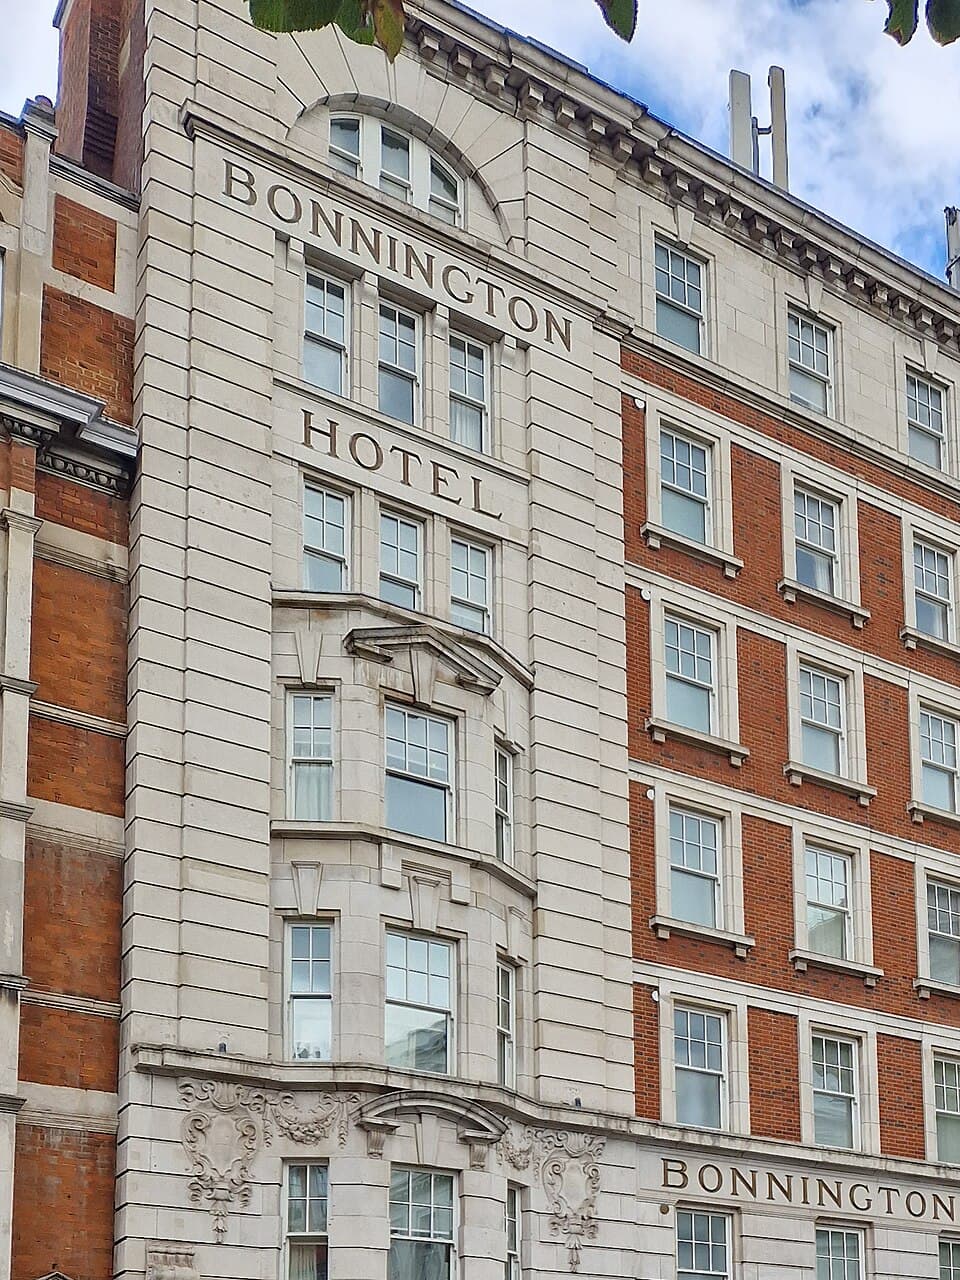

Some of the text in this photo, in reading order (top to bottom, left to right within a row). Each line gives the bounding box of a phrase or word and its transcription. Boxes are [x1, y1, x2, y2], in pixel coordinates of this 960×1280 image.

[222, 158, 573, 353] BONNINGTON
[300, 408, 503, 520] HOTEL
[660, 1157, 956, 1222] BONNINGTON
